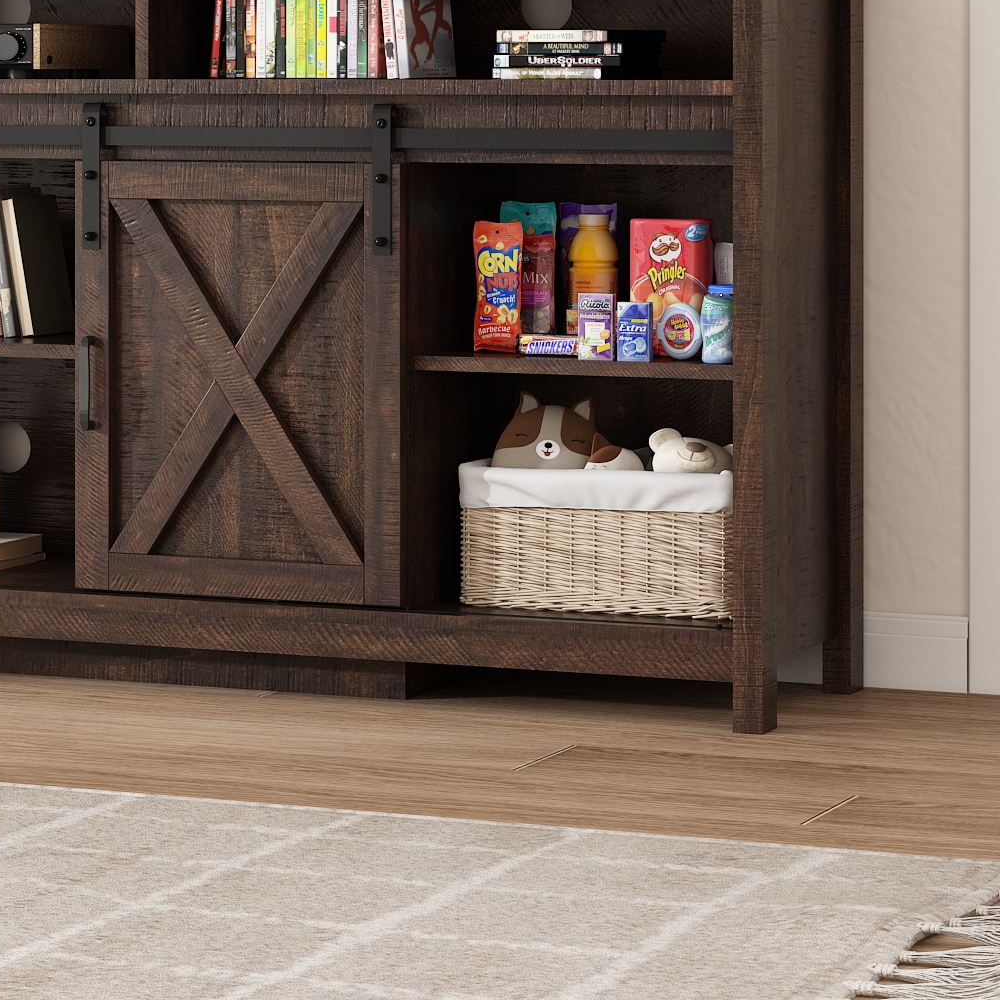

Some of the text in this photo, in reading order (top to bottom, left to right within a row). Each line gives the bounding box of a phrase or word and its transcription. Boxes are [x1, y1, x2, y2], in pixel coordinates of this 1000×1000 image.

[349, 37, 358, 60] HEART
[687, 224, 697, 238] 2
[477, 248, 519, 278] CORN
[486, 272, 520, 292] NUTS
[523, 271, 549, 284] MIX
[647, 259, 687, 293] Pringles
[658, 284, 681, 296] ORIGINAL
[492, 294, 516, 305] Crunch!
[580, 298, 610, 310] Ricola
[477, 325, 511, 336] Barbecue
[619, 323, 648, 332] Extra
[527, 340, 574, 354] SNICKERS
